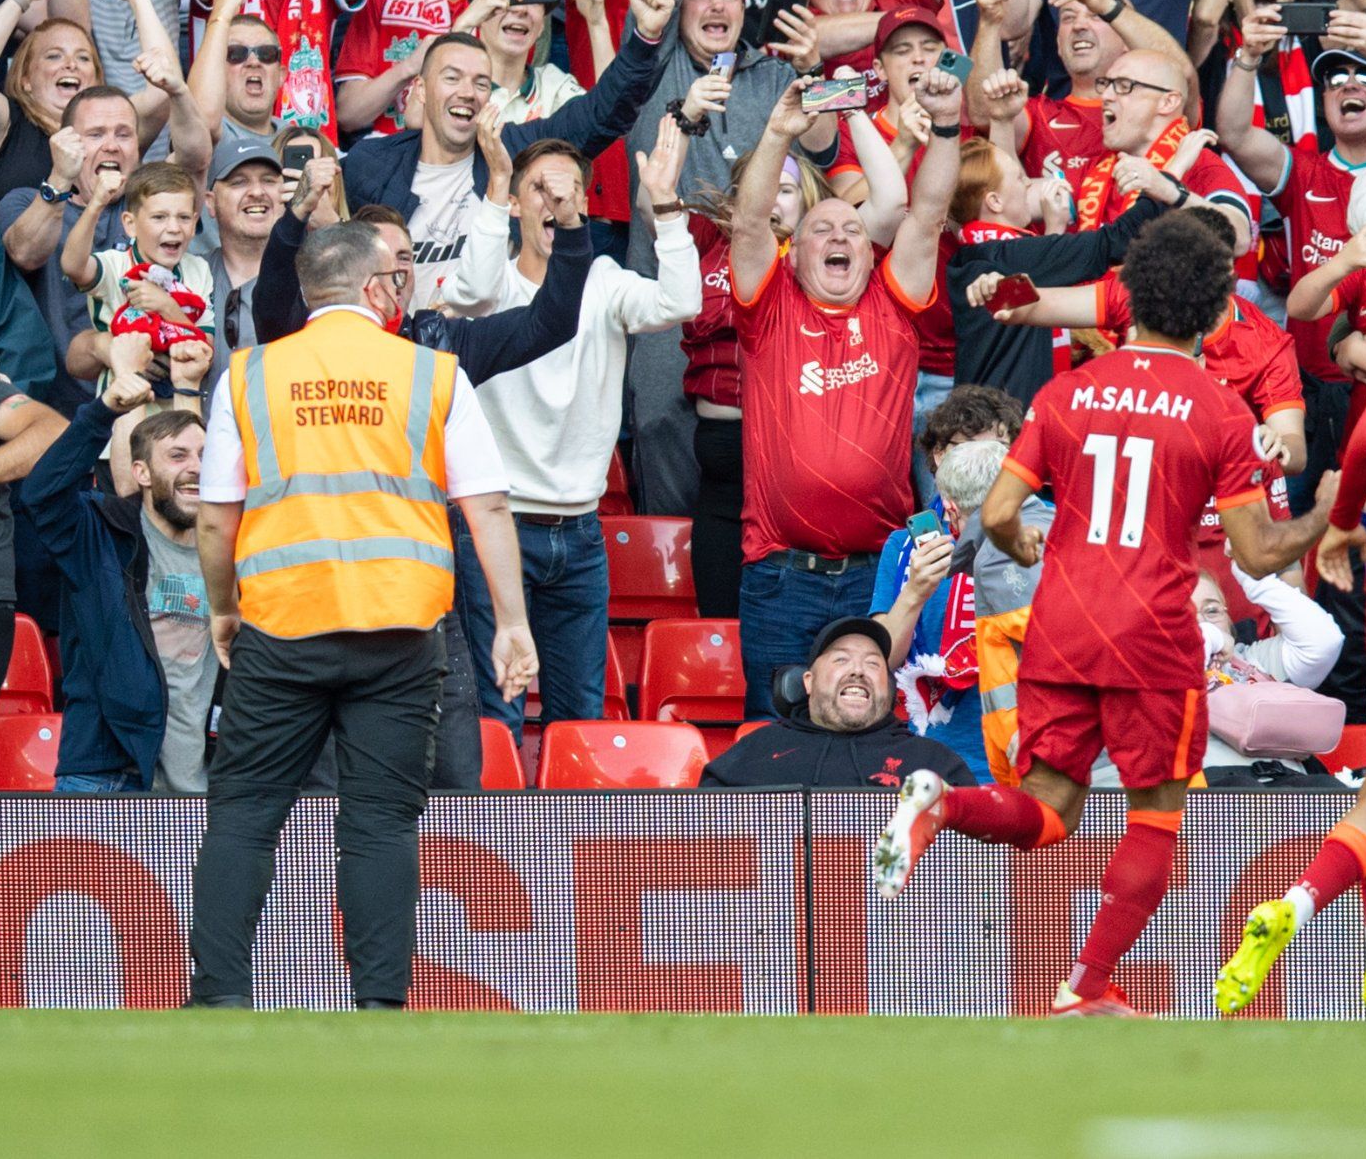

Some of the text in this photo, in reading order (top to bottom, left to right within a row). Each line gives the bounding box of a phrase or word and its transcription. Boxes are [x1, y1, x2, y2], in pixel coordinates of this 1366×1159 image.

[290, 380, 388, 401] RESPONSE
[1070, 386, 1193, 422] M.SALAH
[296, 405, 383, 427] STEWARD
[1082, 432, 1154, 548] 11
